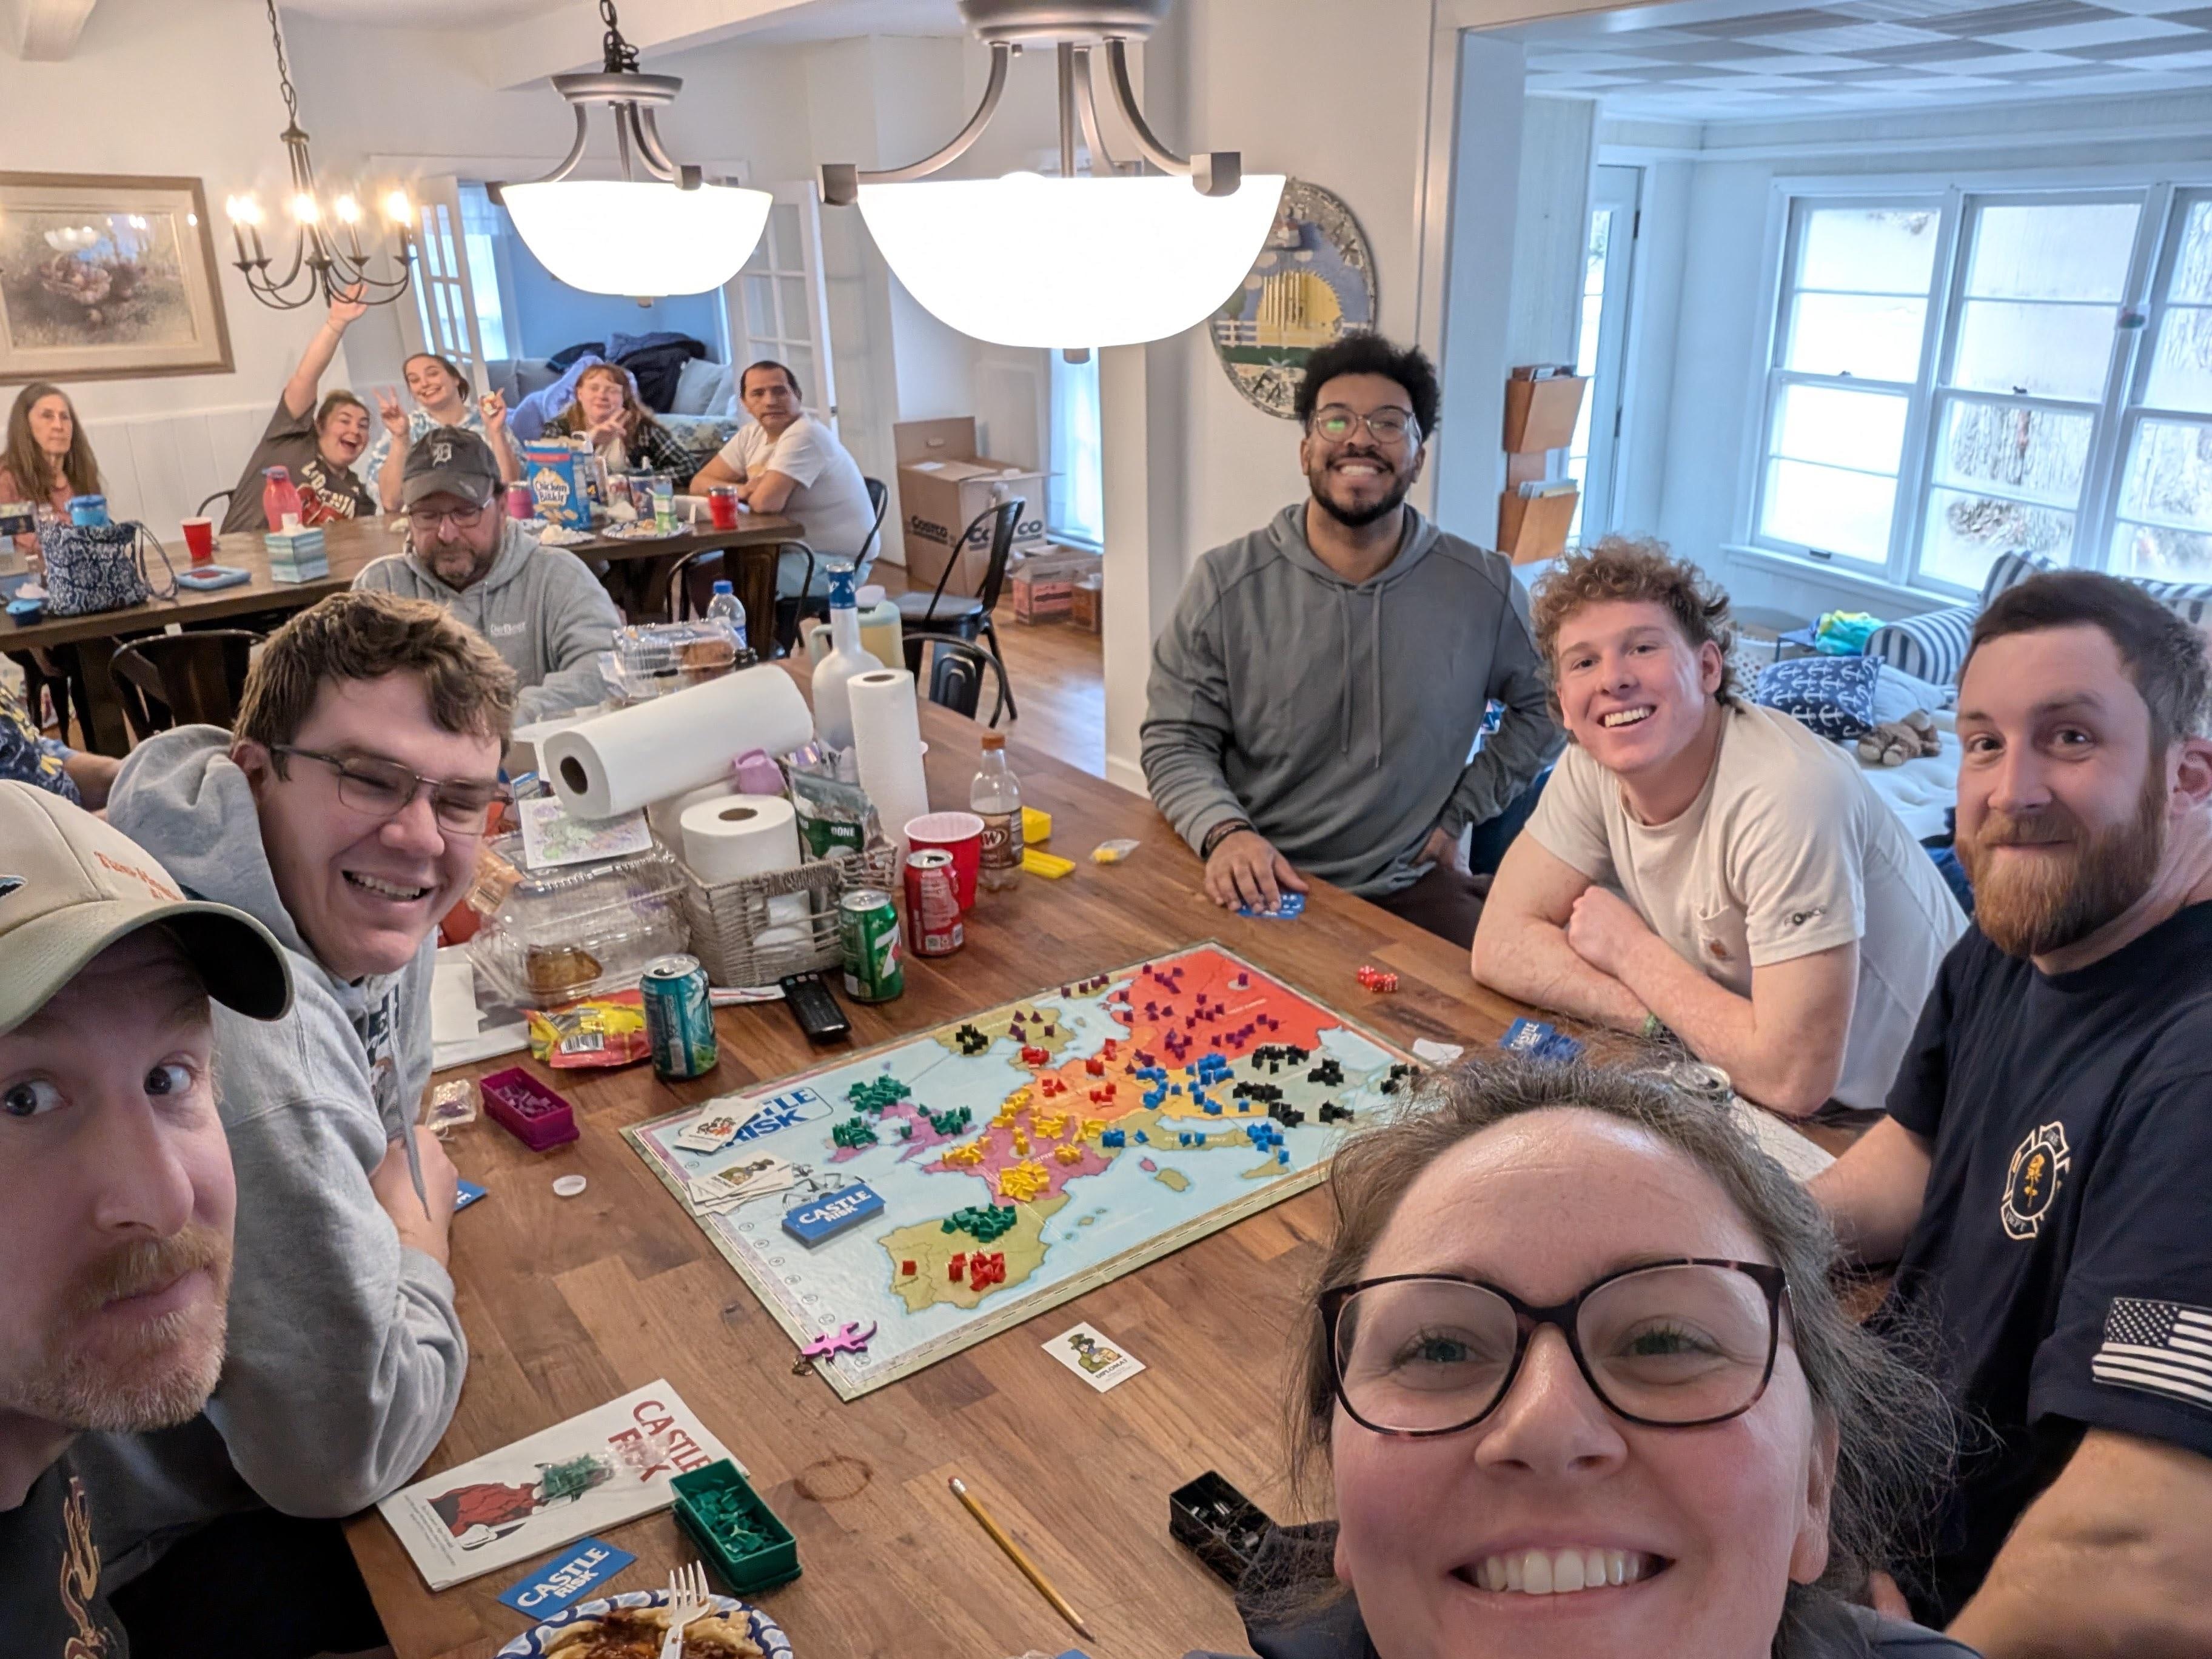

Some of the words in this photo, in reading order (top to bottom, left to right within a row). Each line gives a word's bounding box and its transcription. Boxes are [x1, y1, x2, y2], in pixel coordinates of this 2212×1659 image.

[799, 1190, 871, 1224] CASTLE
[1095, 1358, 1128, 1379] DIPLOMAT
[517, 1547, 610, 1607] CASTLE
[554, 1569, 599, 1598] RISK
